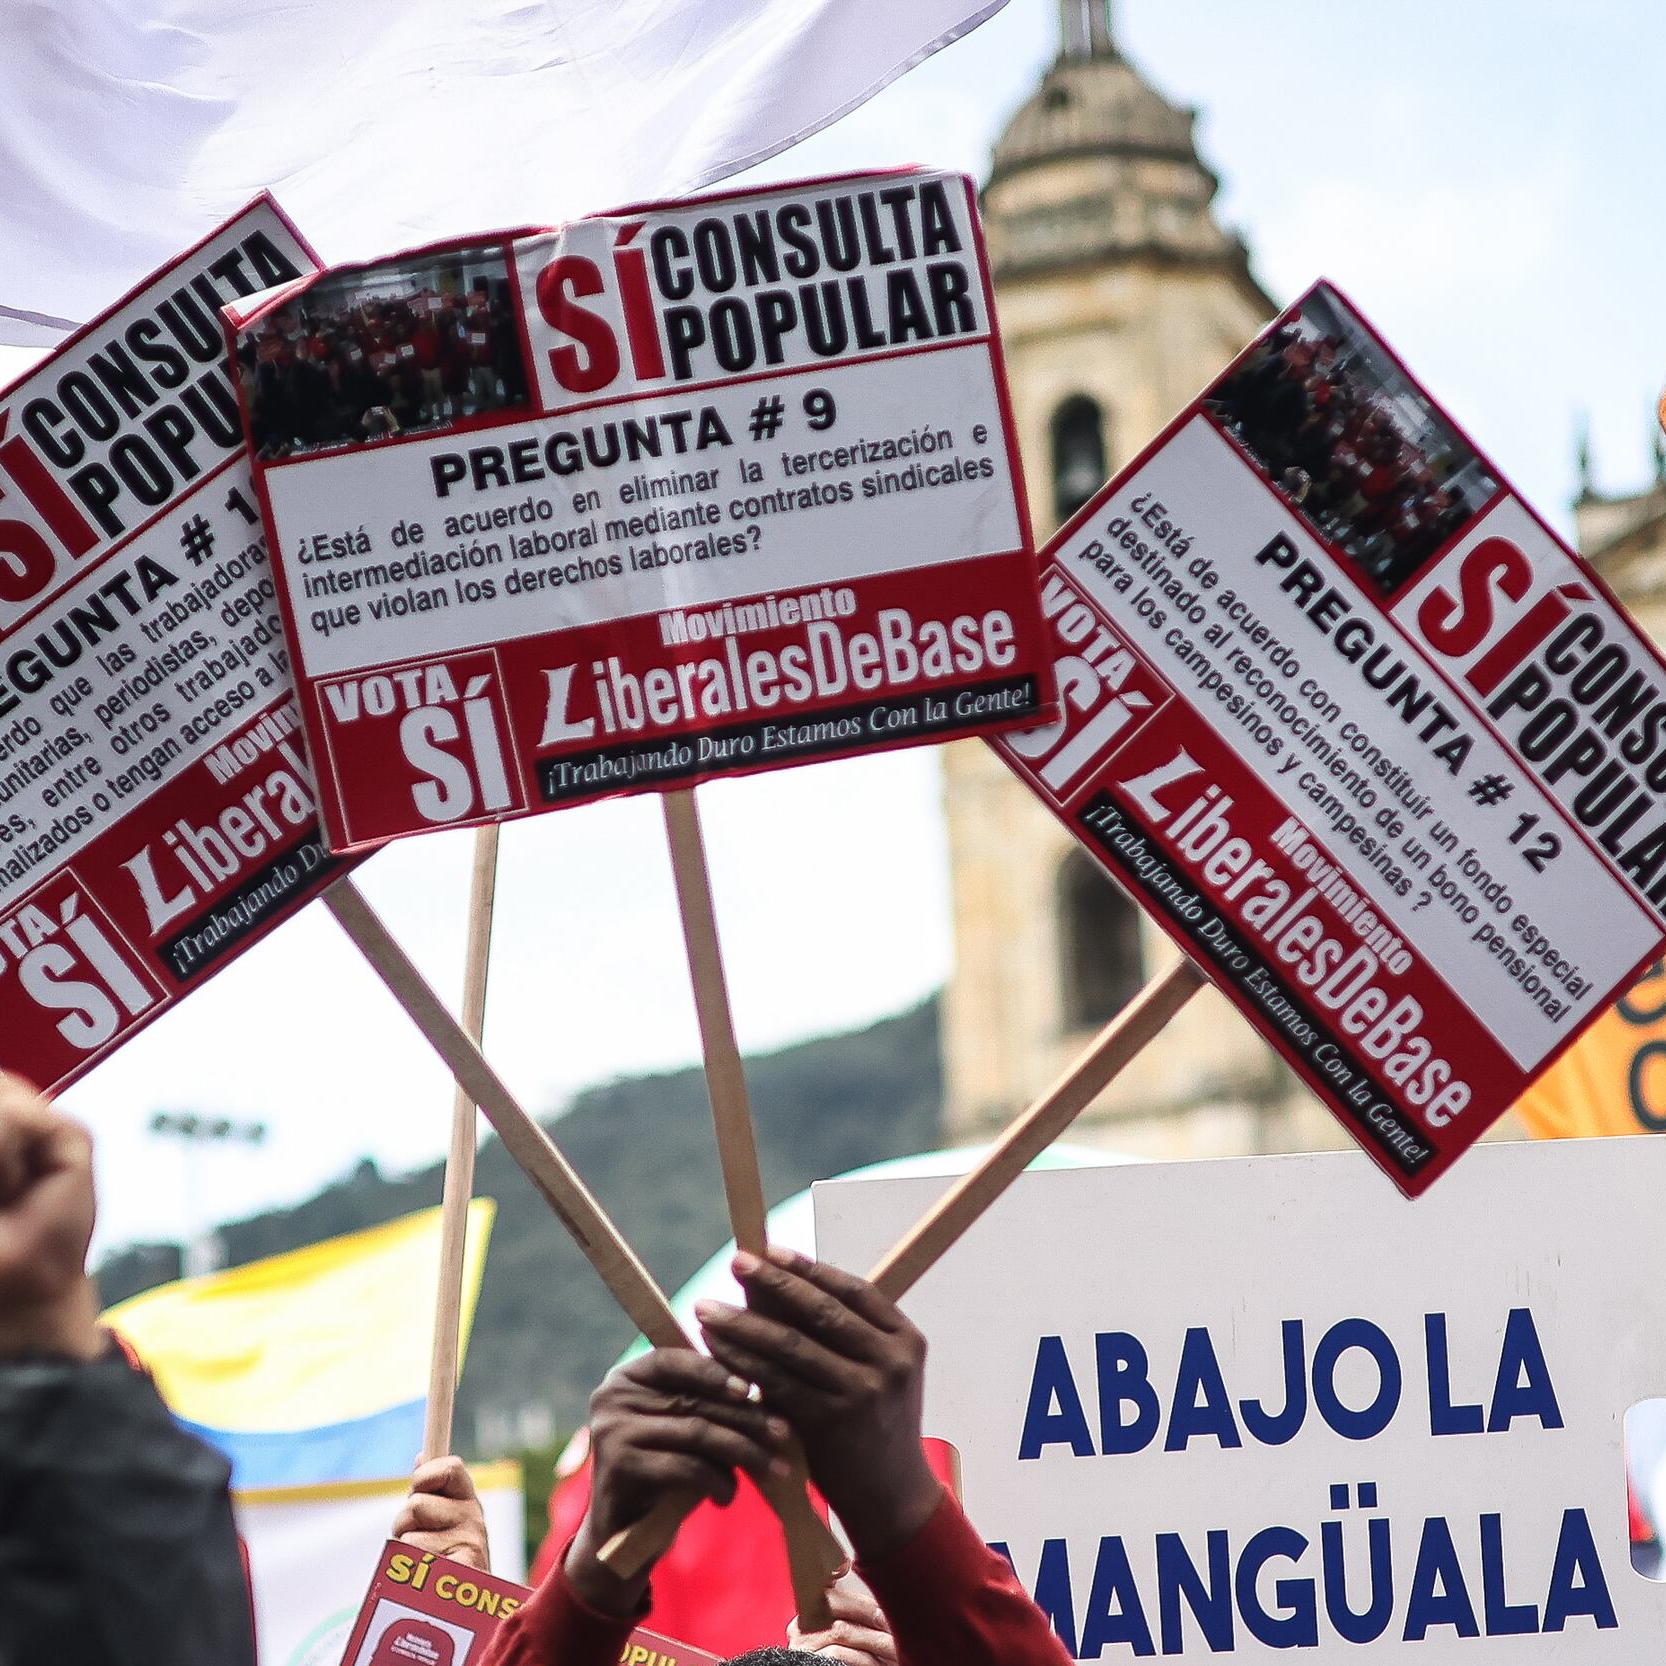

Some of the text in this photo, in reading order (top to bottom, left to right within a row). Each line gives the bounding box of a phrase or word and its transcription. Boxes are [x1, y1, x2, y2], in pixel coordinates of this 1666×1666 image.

[535, 180, 962, 393] SÍ CONSULTA
[663, 261, 977, 380] POPULAR
[297, 424, 953, 564] ¿Está de acuerdo en eliminar la tercerización
[429, 389, 836, 498] PREGUNTA # 9
[302, 456, 993, 598] intermediación laboral mediante contratos sindicales
[310, 524, 761, 637] que violan los derechos laborales?
[49, 676, 93, 716] que
[94, 643, 136, 677] las
[93, 630, 217, 730] periodistas,
[536, 608, 1015, 747] LiberalesDeBase
[658, 588, 856, 645] Movimiento
[1040, 573, 1137, 691] VOTA
[1417, 537, 1594, 698] SÍ
[41, 756, 102, 807] entre
[110, 702, 171, 754] otros
[105, 737, 182, 798] tengan
[179, 680, 255, 745] acceso
[324, 663, 458, 722] VOTA
[399, 673, 520, 822] SÍ
[548, 682, 1029, 794] ¡Trabajando Duro Estamos Con Gente!
[1003, 655, 1154, 791] SÍ
[1078, 539, 1412, 896] para los campesinos campesinas
[1130, 492, 1593, 1000] ¿Está de acuerdo con constituir un fondo especial
[1254, 531, 1561, 873] PREGUNTA # 12
[1107, 517, 1571, 1023] destinado al reconocimiento de un bono pensional
[172, 865, 297, 973] ¡Trabajando
[1118, 745, 1471, 1127] LiberalesDeBase
[1270, 816, 1412, 974] Movimiento
[18, 891, 163, 1063] SÍ
[1085, 805, 1428, 1163] ¡Trabajando Duro Estamos Con Gente!
[1018, 1308, 1564, 1460] ABAJO LA
[386, 1553, 436, 1592] SÍ
[985, 1481, 1618, 1660] MANGÜALA
